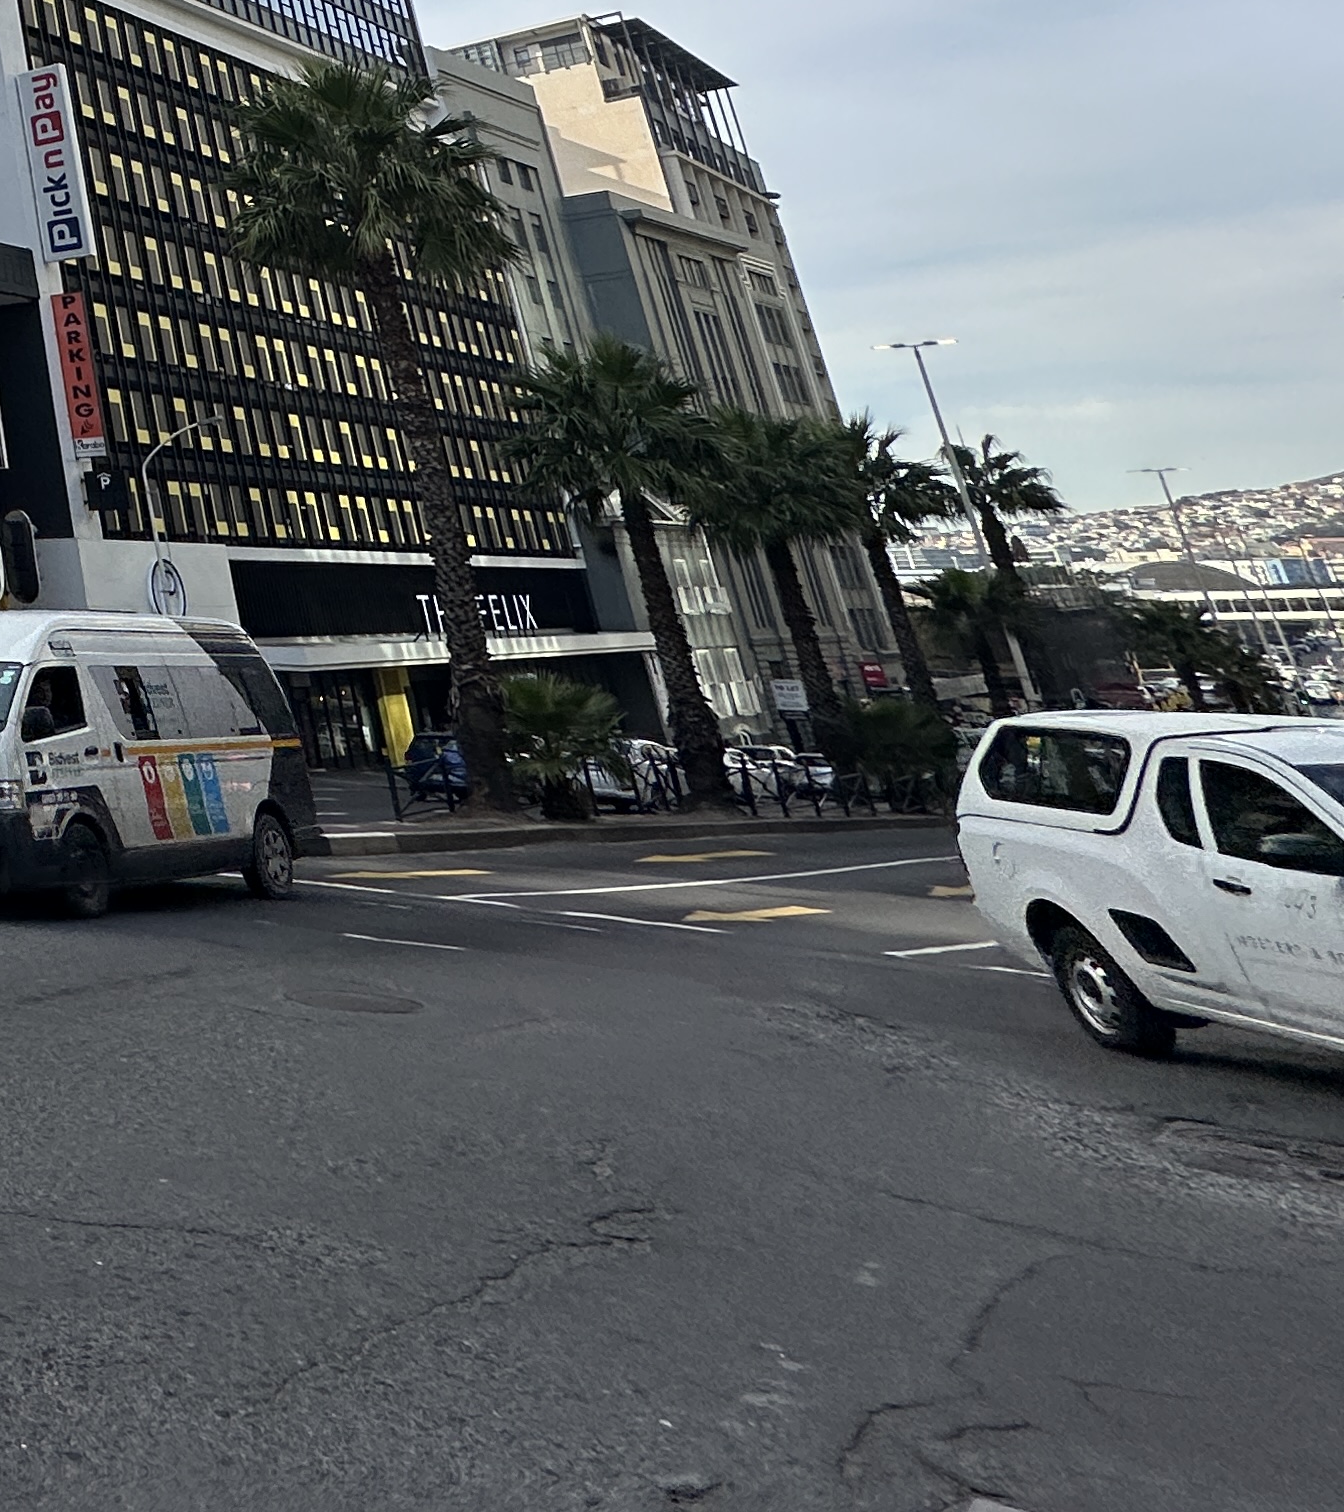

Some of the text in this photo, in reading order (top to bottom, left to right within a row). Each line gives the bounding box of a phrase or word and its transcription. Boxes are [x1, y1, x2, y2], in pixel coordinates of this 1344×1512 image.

[30, 72, 82, 250] Pick n Pay
[62, 295, 94, 418] PARKING
[100, 476, 110, 490] P
